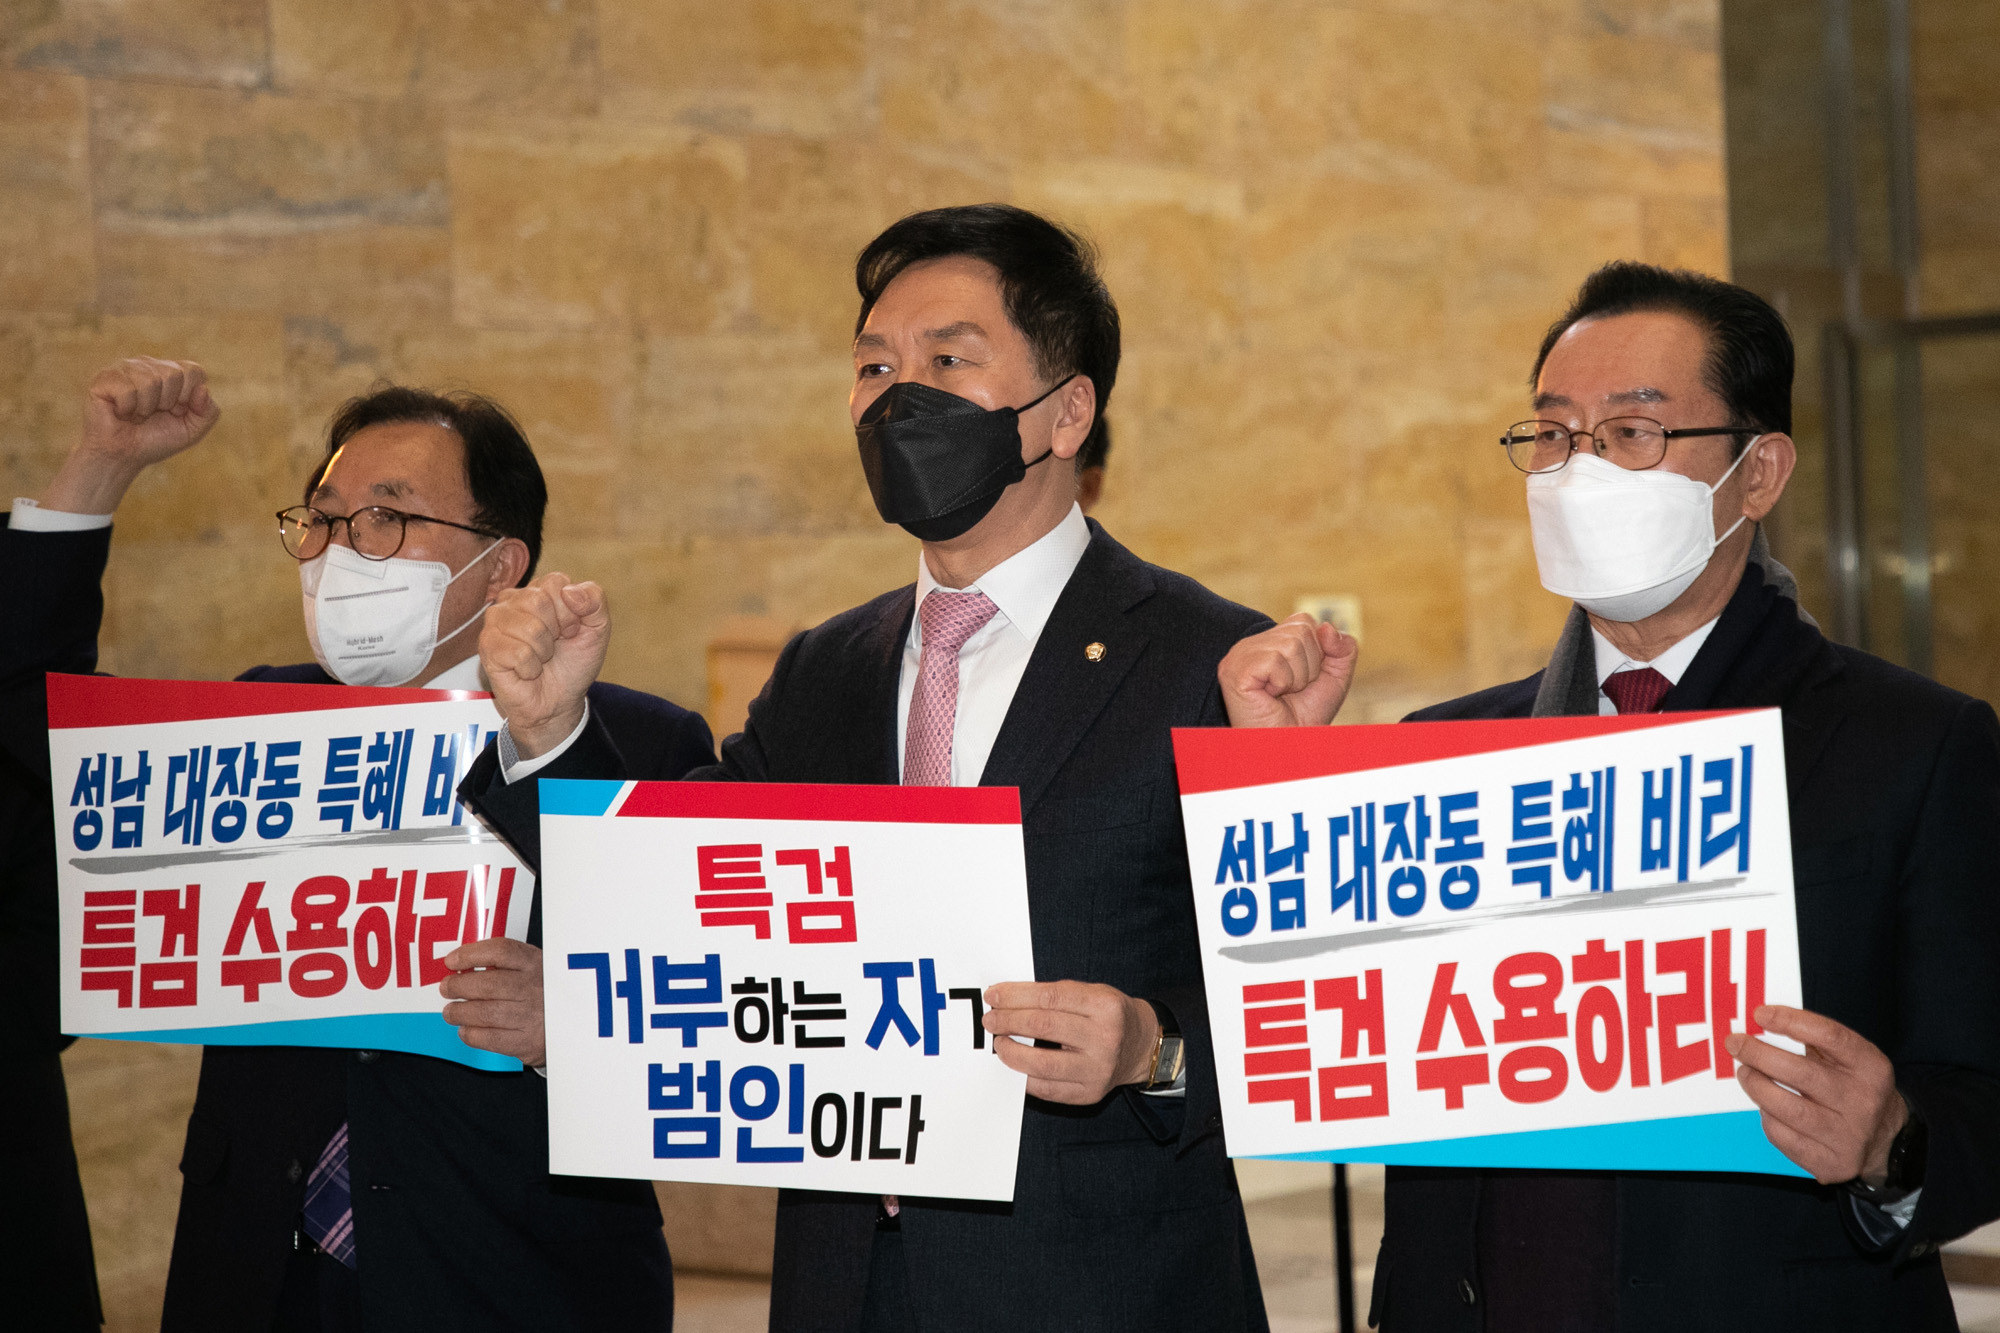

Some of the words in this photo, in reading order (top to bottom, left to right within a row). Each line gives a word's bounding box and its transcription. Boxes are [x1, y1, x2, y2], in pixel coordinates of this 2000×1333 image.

[70, 750, 152, 851] 성남
[163, 741, 302, 846] 대장동
[317, 728, 415, 833] 특혜
[421, 723, 499, 826] 비
[1215, 812, 1310, 938] 성남
[1328, 791, 1485, 922] 대장동
[1506, 766, 1617, 899] 특혜
[1640, 744, 1755, 883] 비리
[80, 883, 201, 1010] 특검
[694, 843, 859, 945] 특검
[567, 948, 848, 1049] 거부하는
[1242, 968, 1390, 1124] 특검
[647, 1060, 926, 1165] 범인이다
